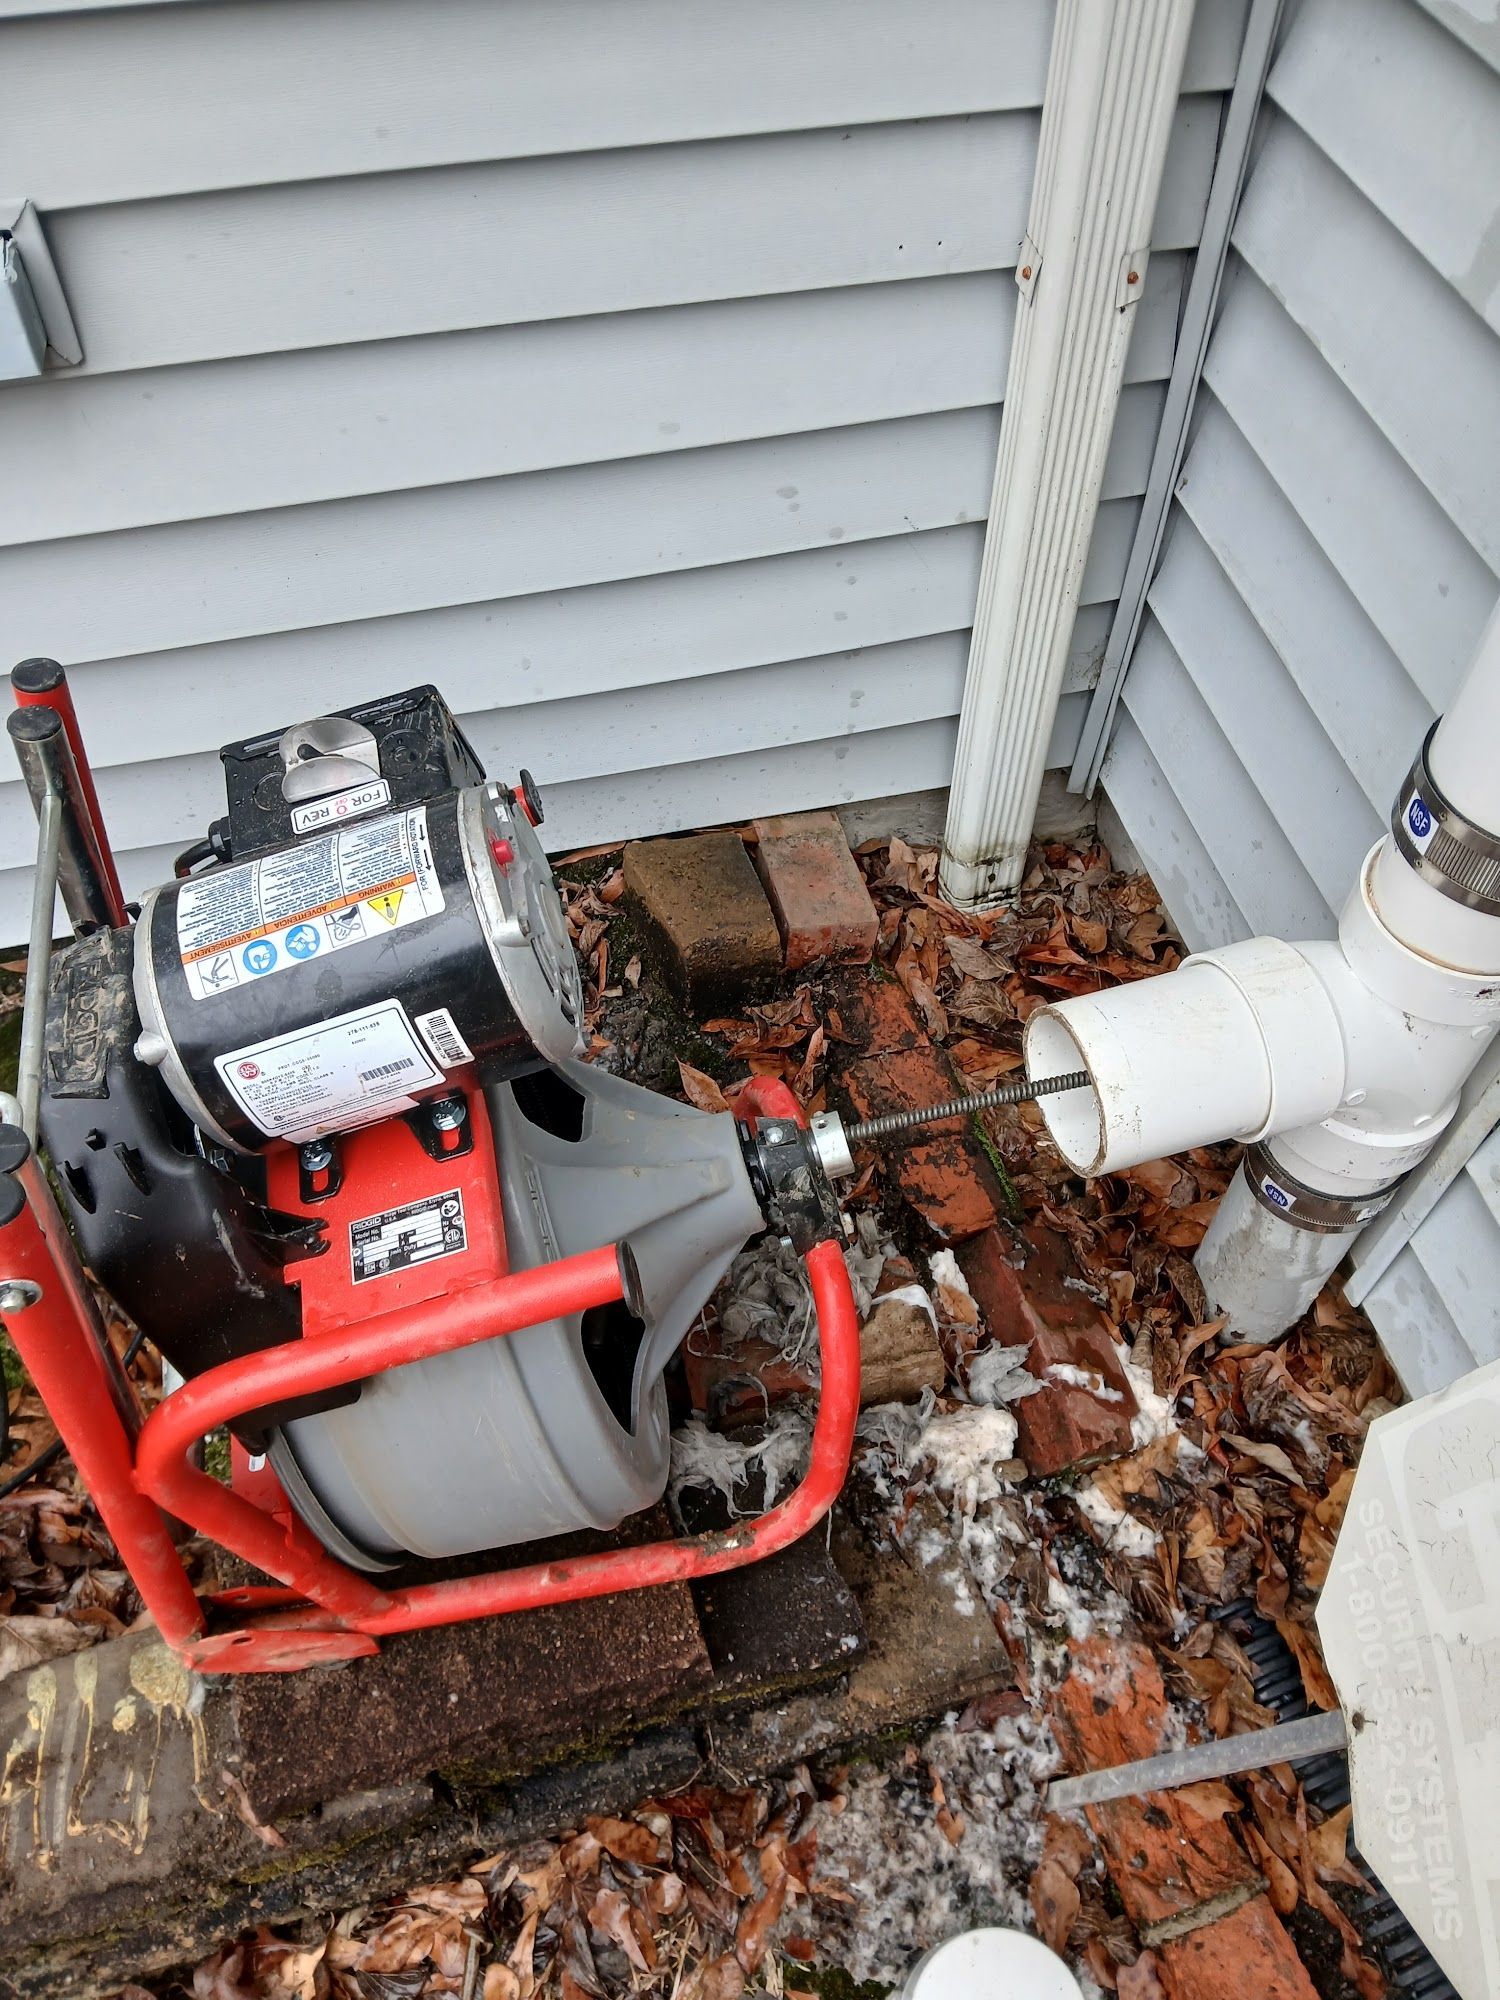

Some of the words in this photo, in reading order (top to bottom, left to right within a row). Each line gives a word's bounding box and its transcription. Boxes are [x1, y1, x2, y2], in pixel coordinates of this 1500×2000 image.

[352, 790, 381, 806] FOR
[302, 807, 330, 824] REV
[1410, 802, 1428, 831] NSF
[358, 883, 396, 899] WARNING
[420, 875, 428, 891] FOR
[274, 905, 327, 928] ADVERTENCIA
[190, 933, 252, 959] AVERTISSEMENT
[1267, 1188, 1285, 1205] NSF
[352, 1217, 381, 1231] RIDGID
[355, 1230, 370, 1240] Model
[404, 1244, 416, 1252] Duty
[1359, 1497, 1433, 1697] SECURITY
[1410, 1715, 1463, 1940] SYSTEMS
